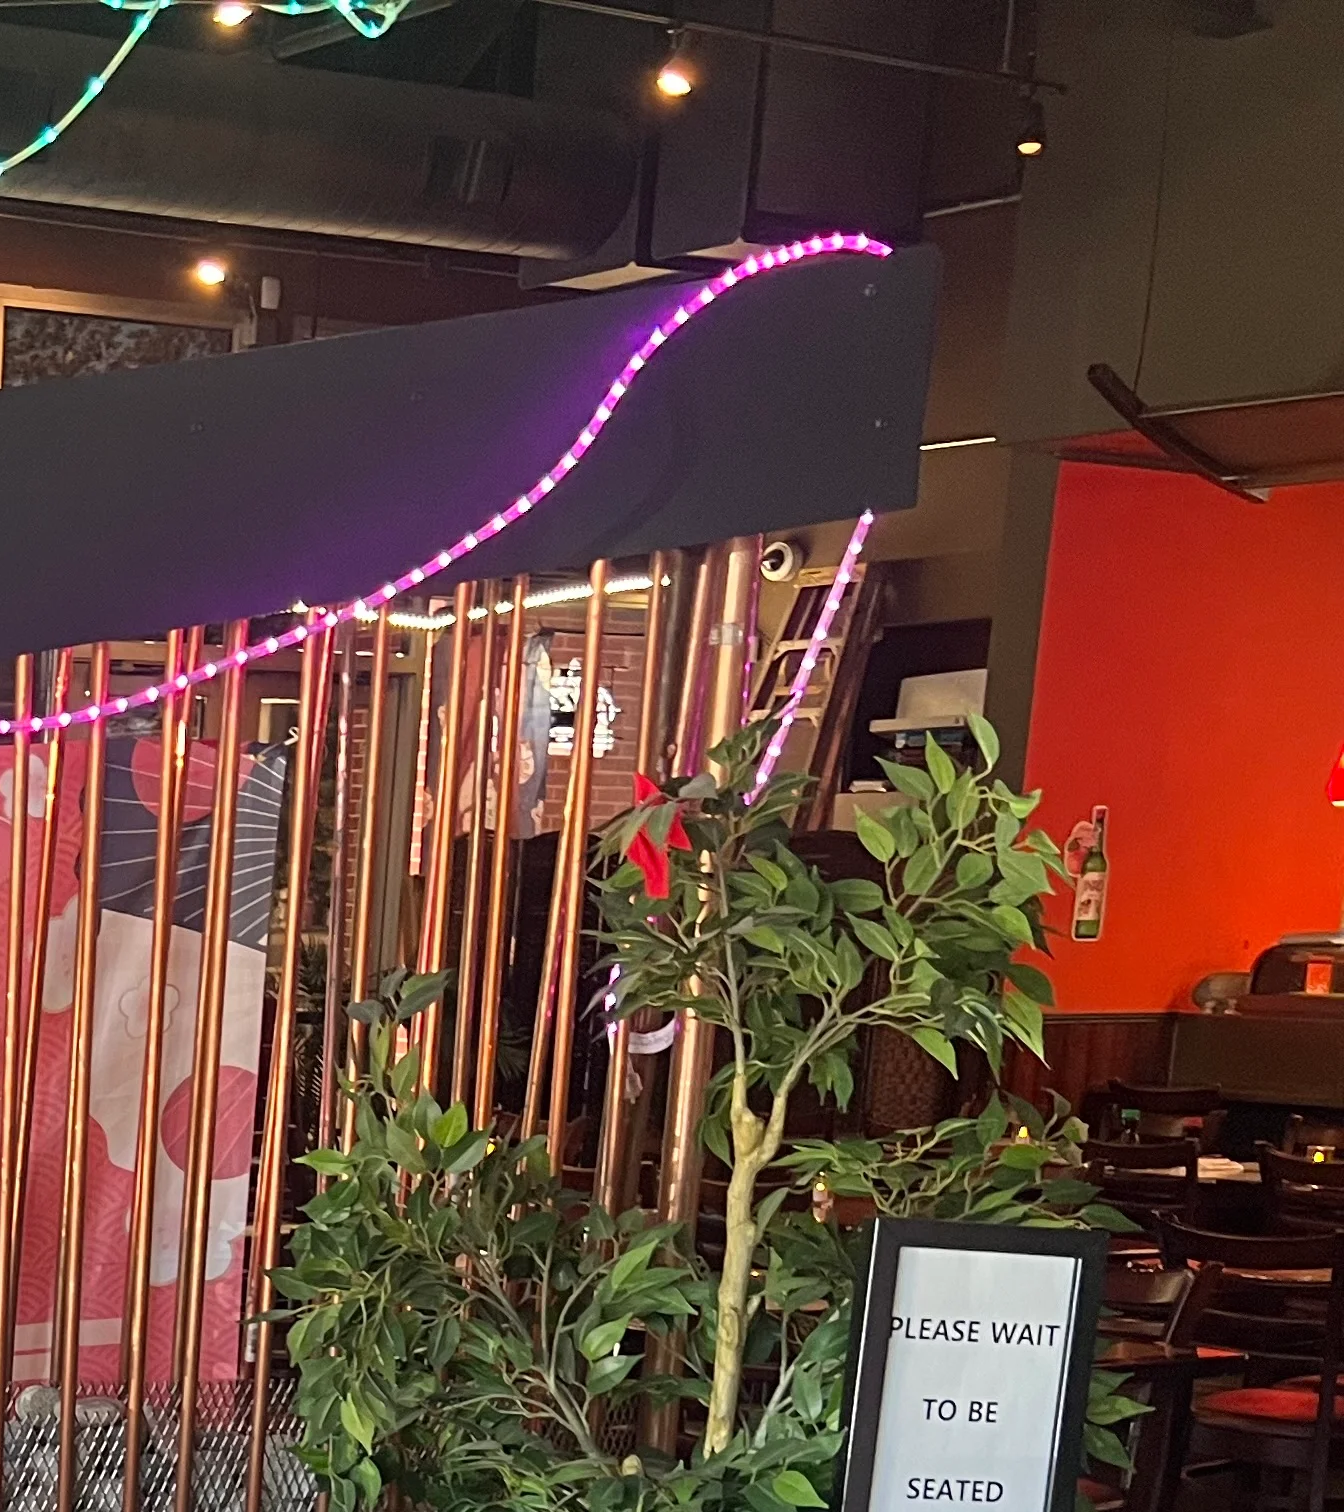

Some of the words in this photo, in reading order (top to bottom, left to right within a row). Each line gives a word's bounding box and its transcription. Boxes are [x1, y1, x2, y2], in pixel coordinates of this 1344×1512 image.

[889, 1315, 980, 1344] PLEASE
[992, 1321, 1061, 1348] WAIT
[923, 1398, 956, 1423] TO
[968, 1400, 998, 1424] BE
[906, 1477, 1004, 1504] SEATED
